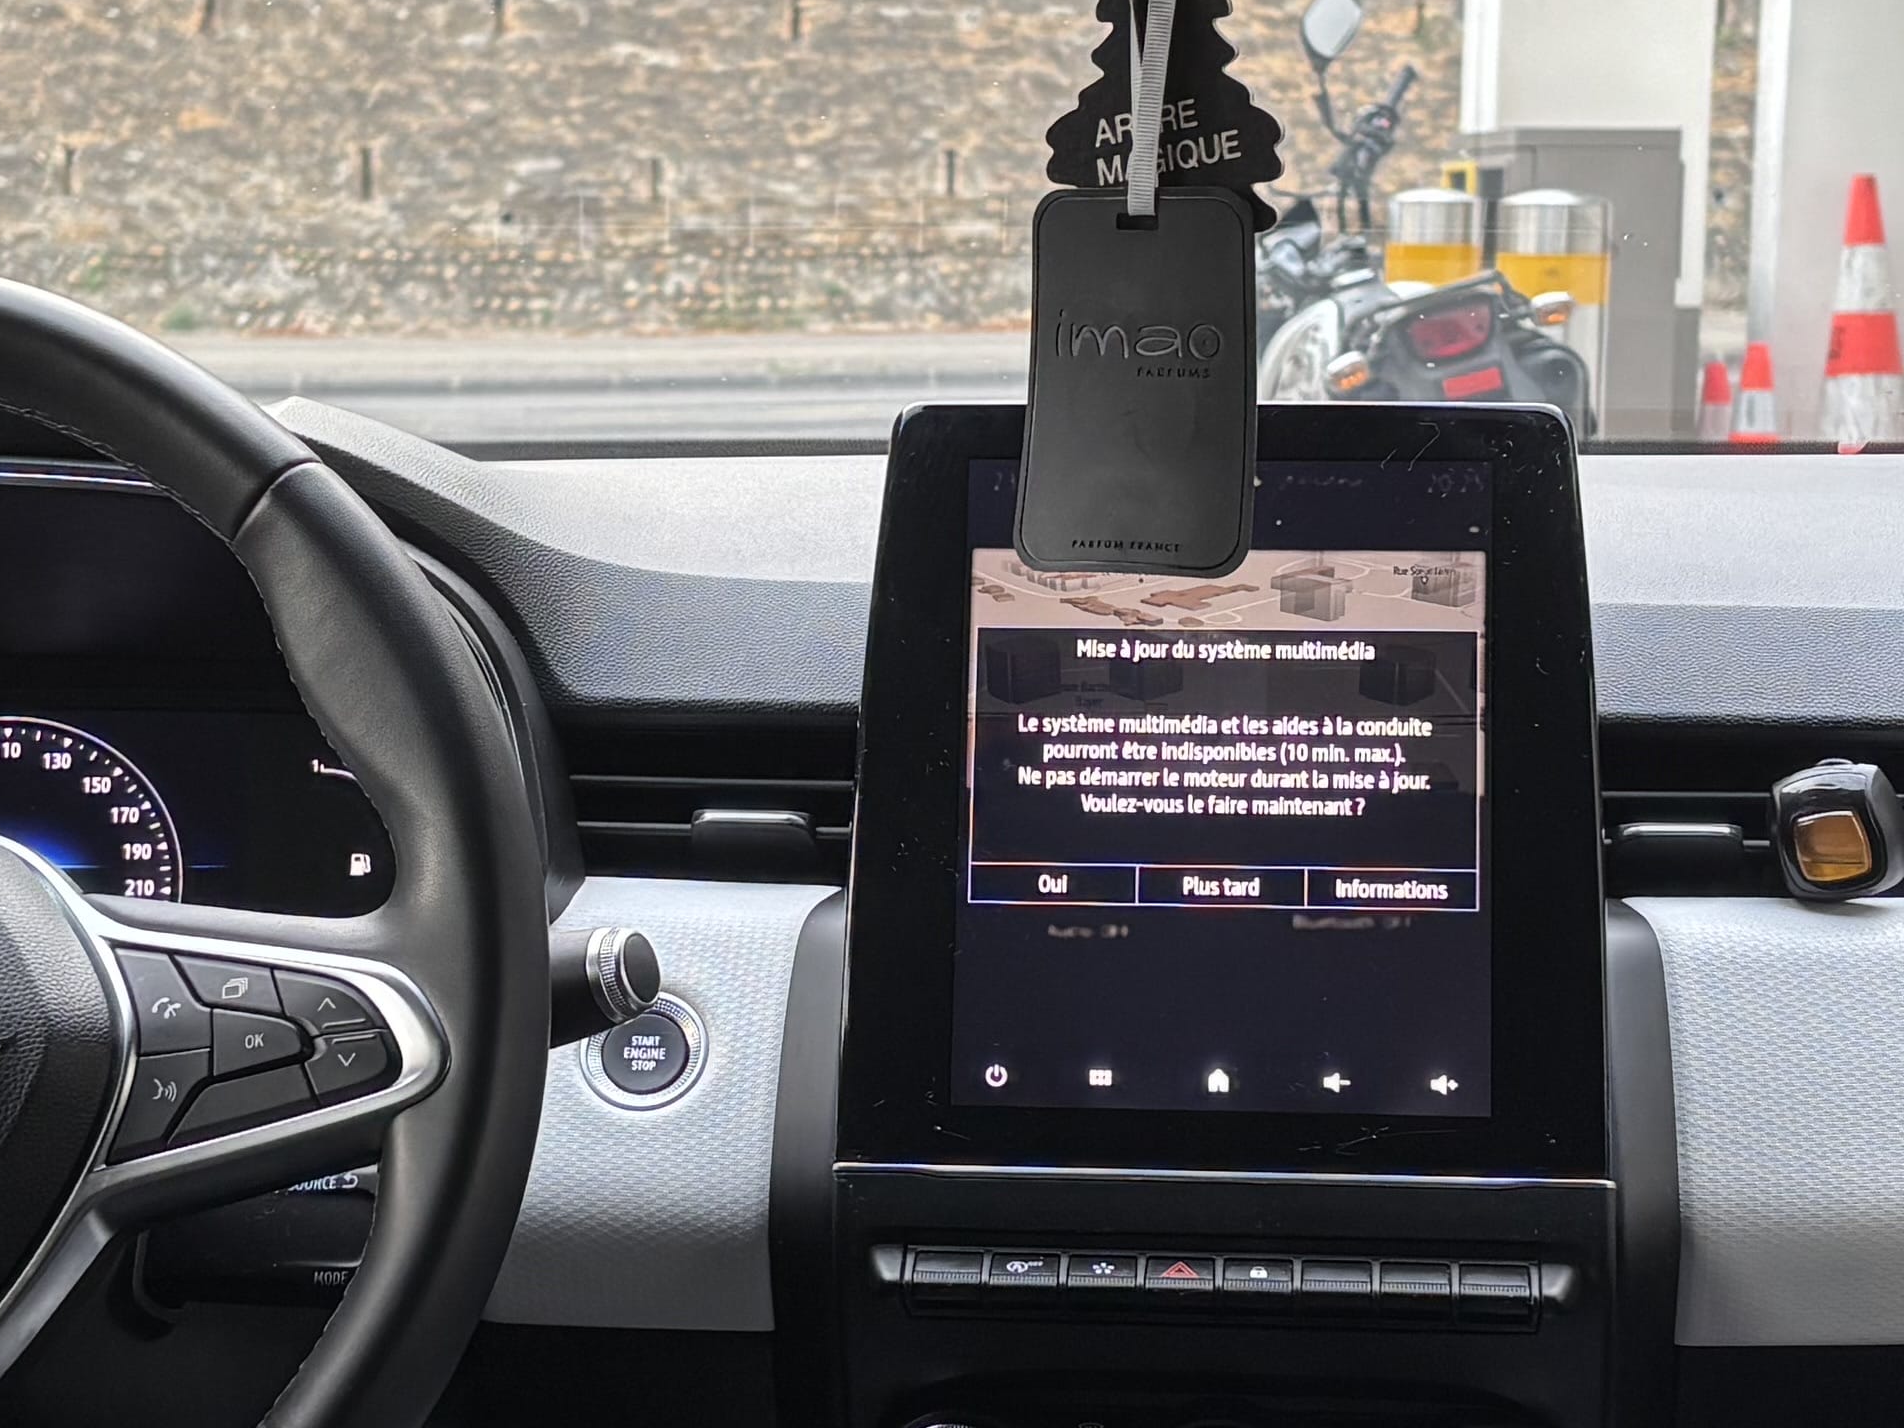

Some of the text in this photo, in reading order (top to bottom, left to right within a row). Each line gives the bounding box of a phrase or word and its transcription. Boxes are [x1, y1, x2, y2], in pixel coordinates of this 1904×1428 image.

[1096, 98, 1198, 148] ARRE
[1097, 129, 1242, 186] MGIQUE
[1056, 309, 1223, 360] imao
[1072, 539, 1124, 549] PARFUM
[1077, 639, 1375, 663] Mise à jour du système multimédia
[1018, 714, 1432, 736] Le système multimédia et les aides à la conduite
[43, 753, 71, 769] 130
[1043, 741, 1119, 762] pourront
[1122, 741, 1157, 760] être
[1162, 742, 1276, 764] indisponibles
[1280, 742, 1308, 765] (10
[1312, 744, 1350, 762] min.
[83, 777, 111, 793] 150
[1019, 766, 1430, 794] Ne pas démarrer le moteur durant la mise à jour.
[1081, 793, 1365, 815] Voulez-vous le faire maintenant ?
[111, 806, 142, 823] 170
[123, 843, 152, 860] 190
[123, 879, 154, 898] 210
[1038, 875, 1067, 893] Oui
[1183, 876, 1260, 896] Plus tard
[1336, 879, 1448, 899] Informations
[245, 1033, 264, 1049] OK
[632, 1035, 660, 1046] START
[624, 1047, 666, 1060] ENGINE
[631, 1060, 656, 1071] STOP
[313, 1270, 347, 1286] MODE
